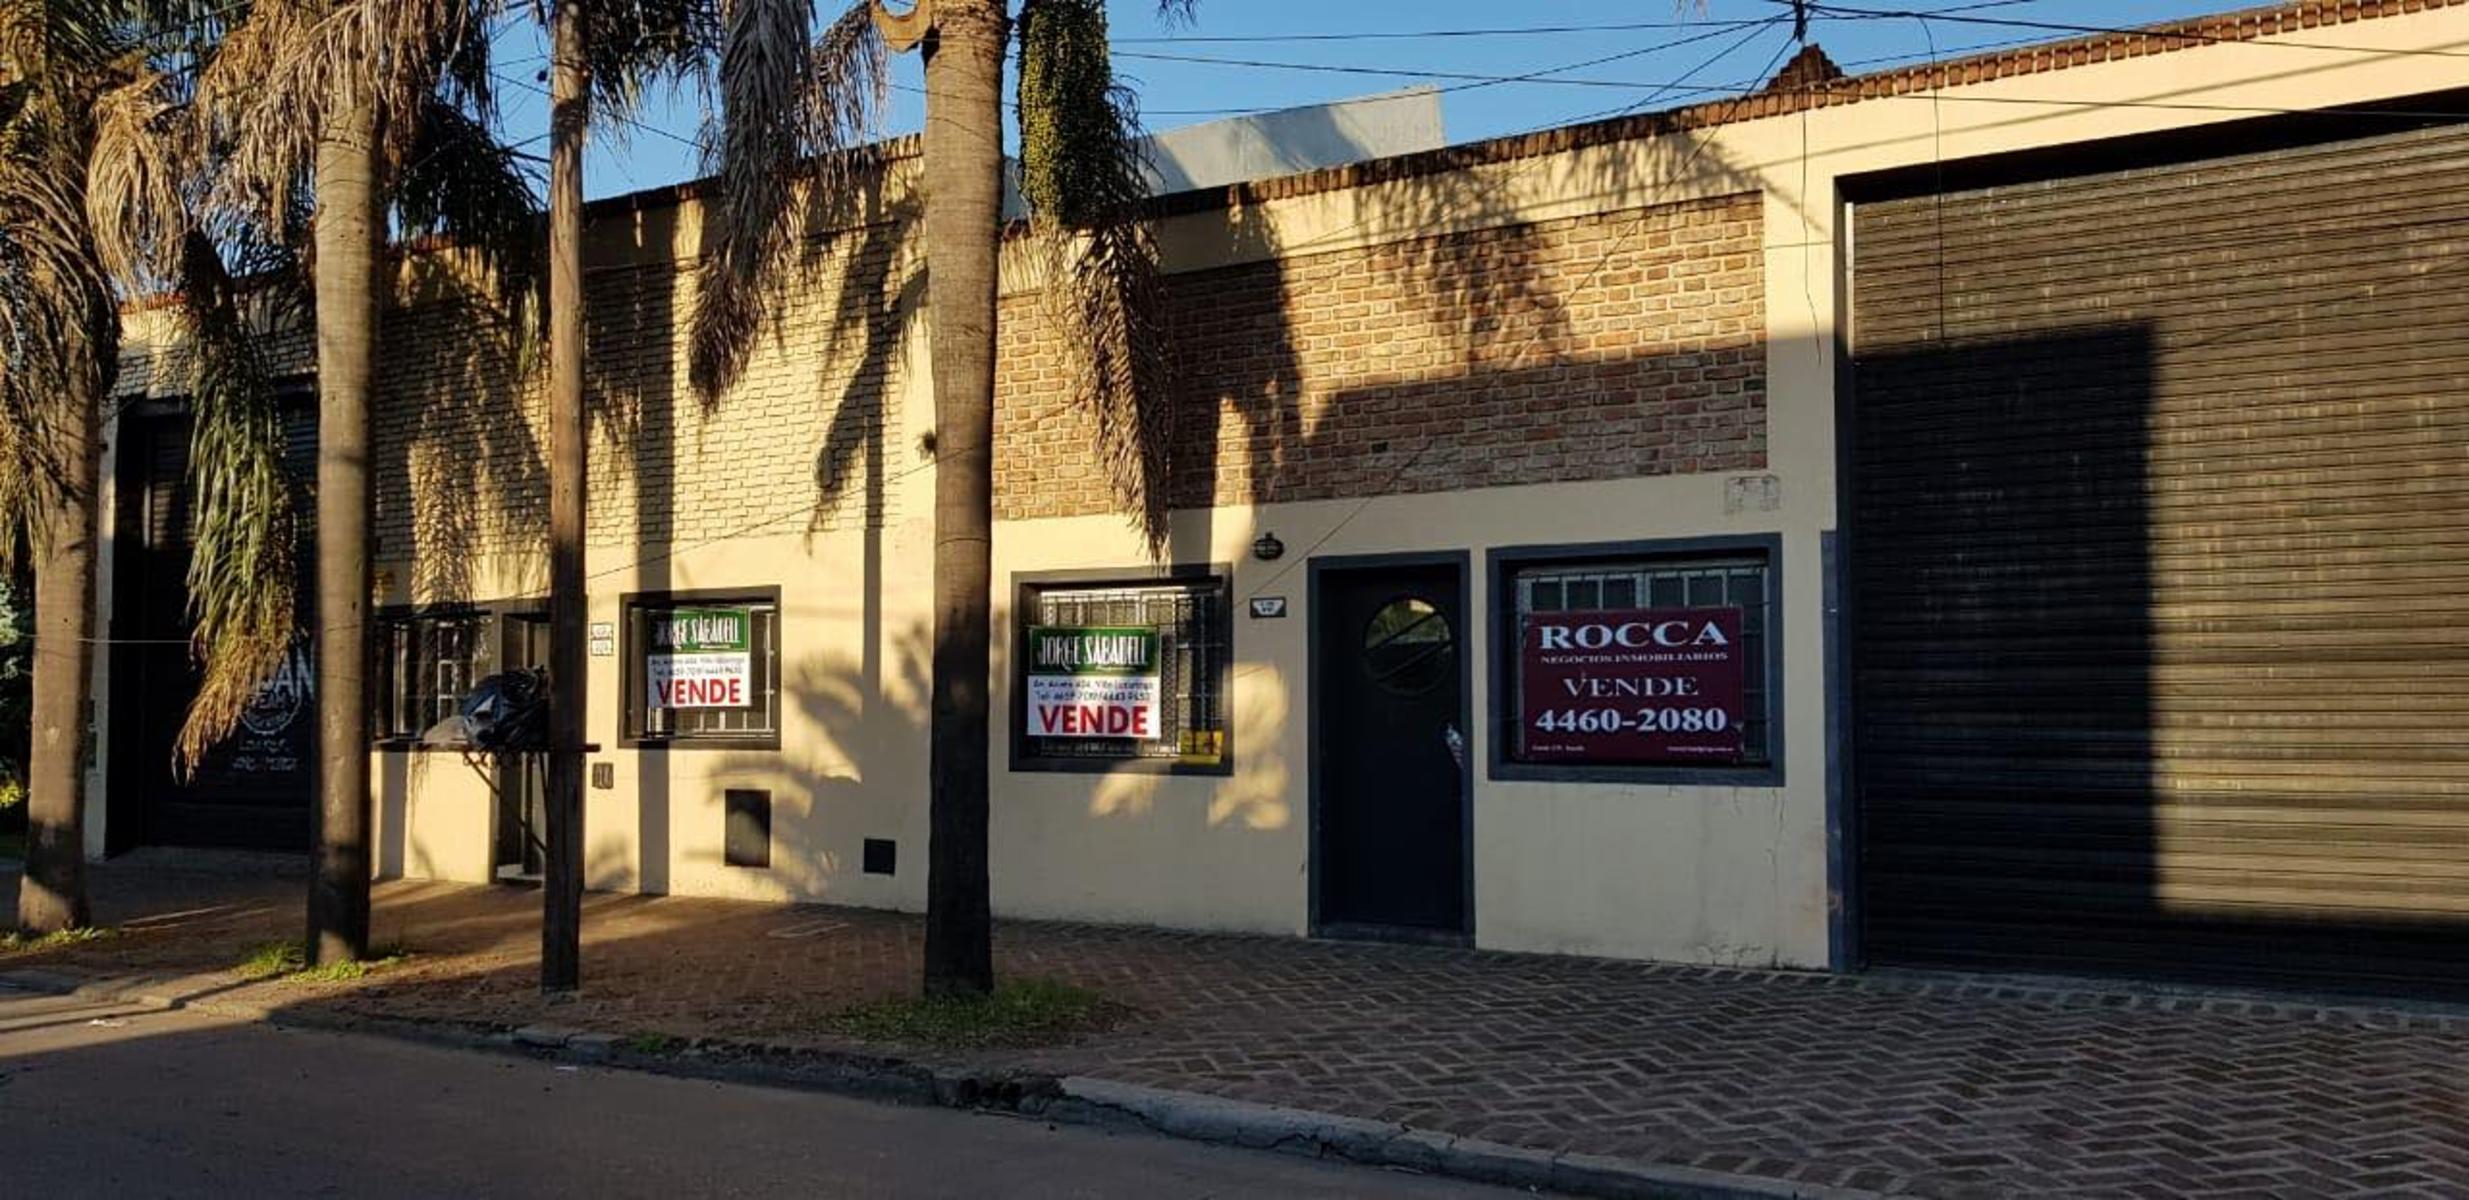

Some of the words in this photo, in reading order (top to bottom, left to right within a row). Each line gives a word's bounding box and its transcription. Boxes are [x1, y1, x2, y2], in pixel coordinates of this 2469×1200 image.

[690, 614, 741, 644] SABADELL
[1540, 620, 1729, 649] ROCCA
[1038, 635, 1081, 672] JORGE
[1083, 632, 1147, 665] SABADELL
[1541, 654, 1613, 664] NEGOCIOS
[1615, 651, 1729, 663] INMOBILIARIOS
[656, 678, 741, 705] VENDE
[1563, 676, 1699, 697] VENDE
[1038, 704, 1148, 735] VENDE
[1535, 708, 1727, 732] 4460-2080
